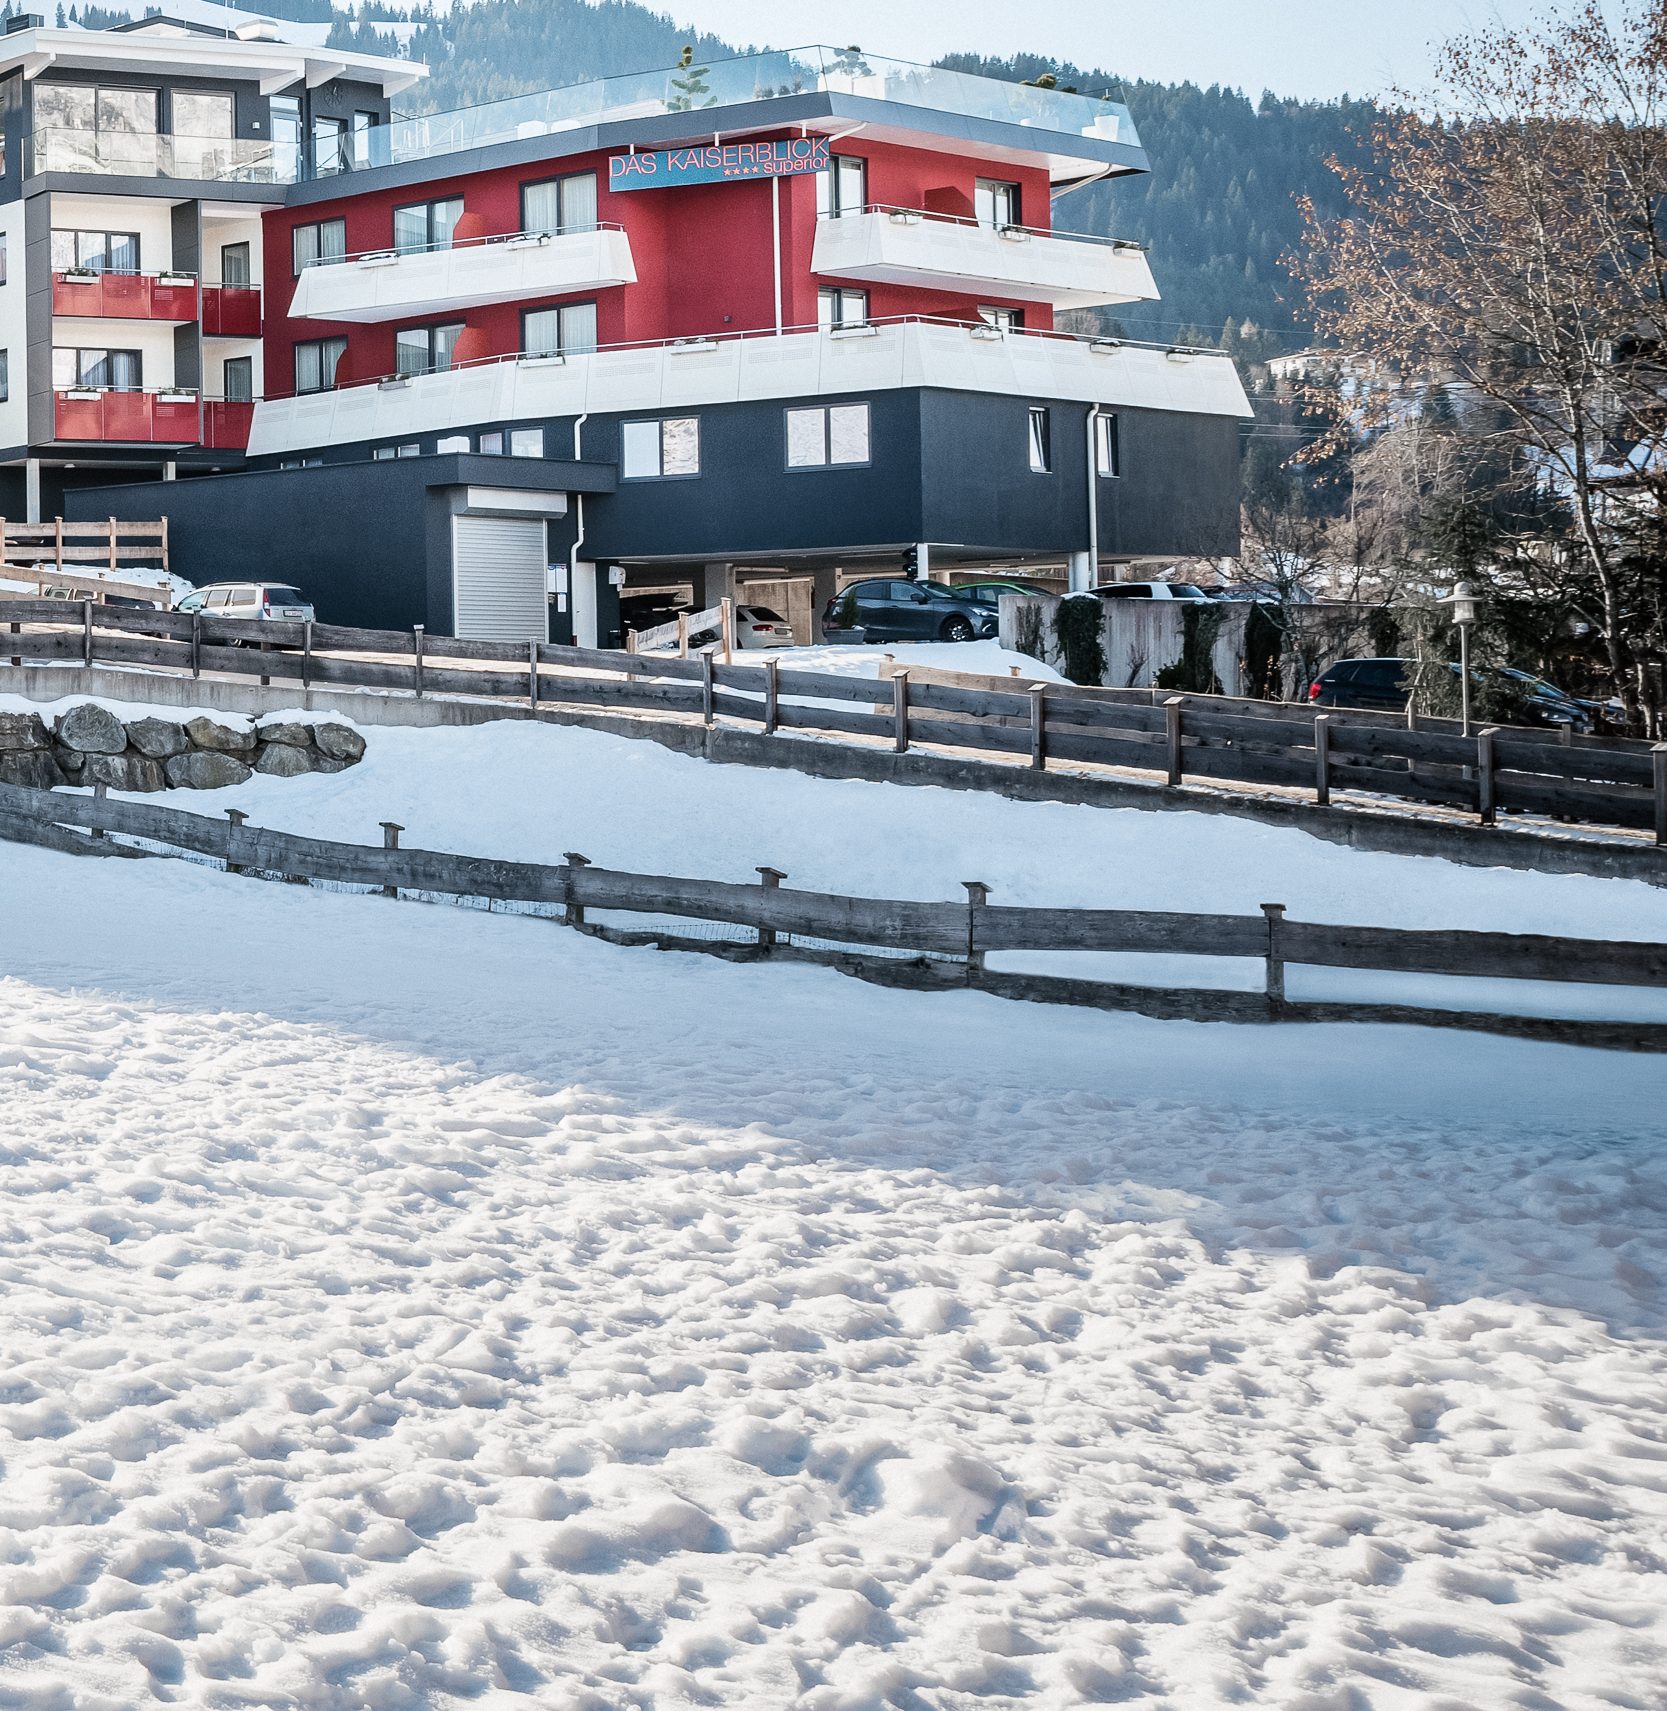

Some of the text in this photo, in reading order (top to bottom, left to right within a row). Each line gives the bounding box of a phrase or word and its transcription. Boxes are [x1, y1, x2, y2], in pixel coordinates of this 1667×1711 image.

[608, 135, 829, 177] DAS KAISERBLICK
[763, 155, 828, 177] superior
